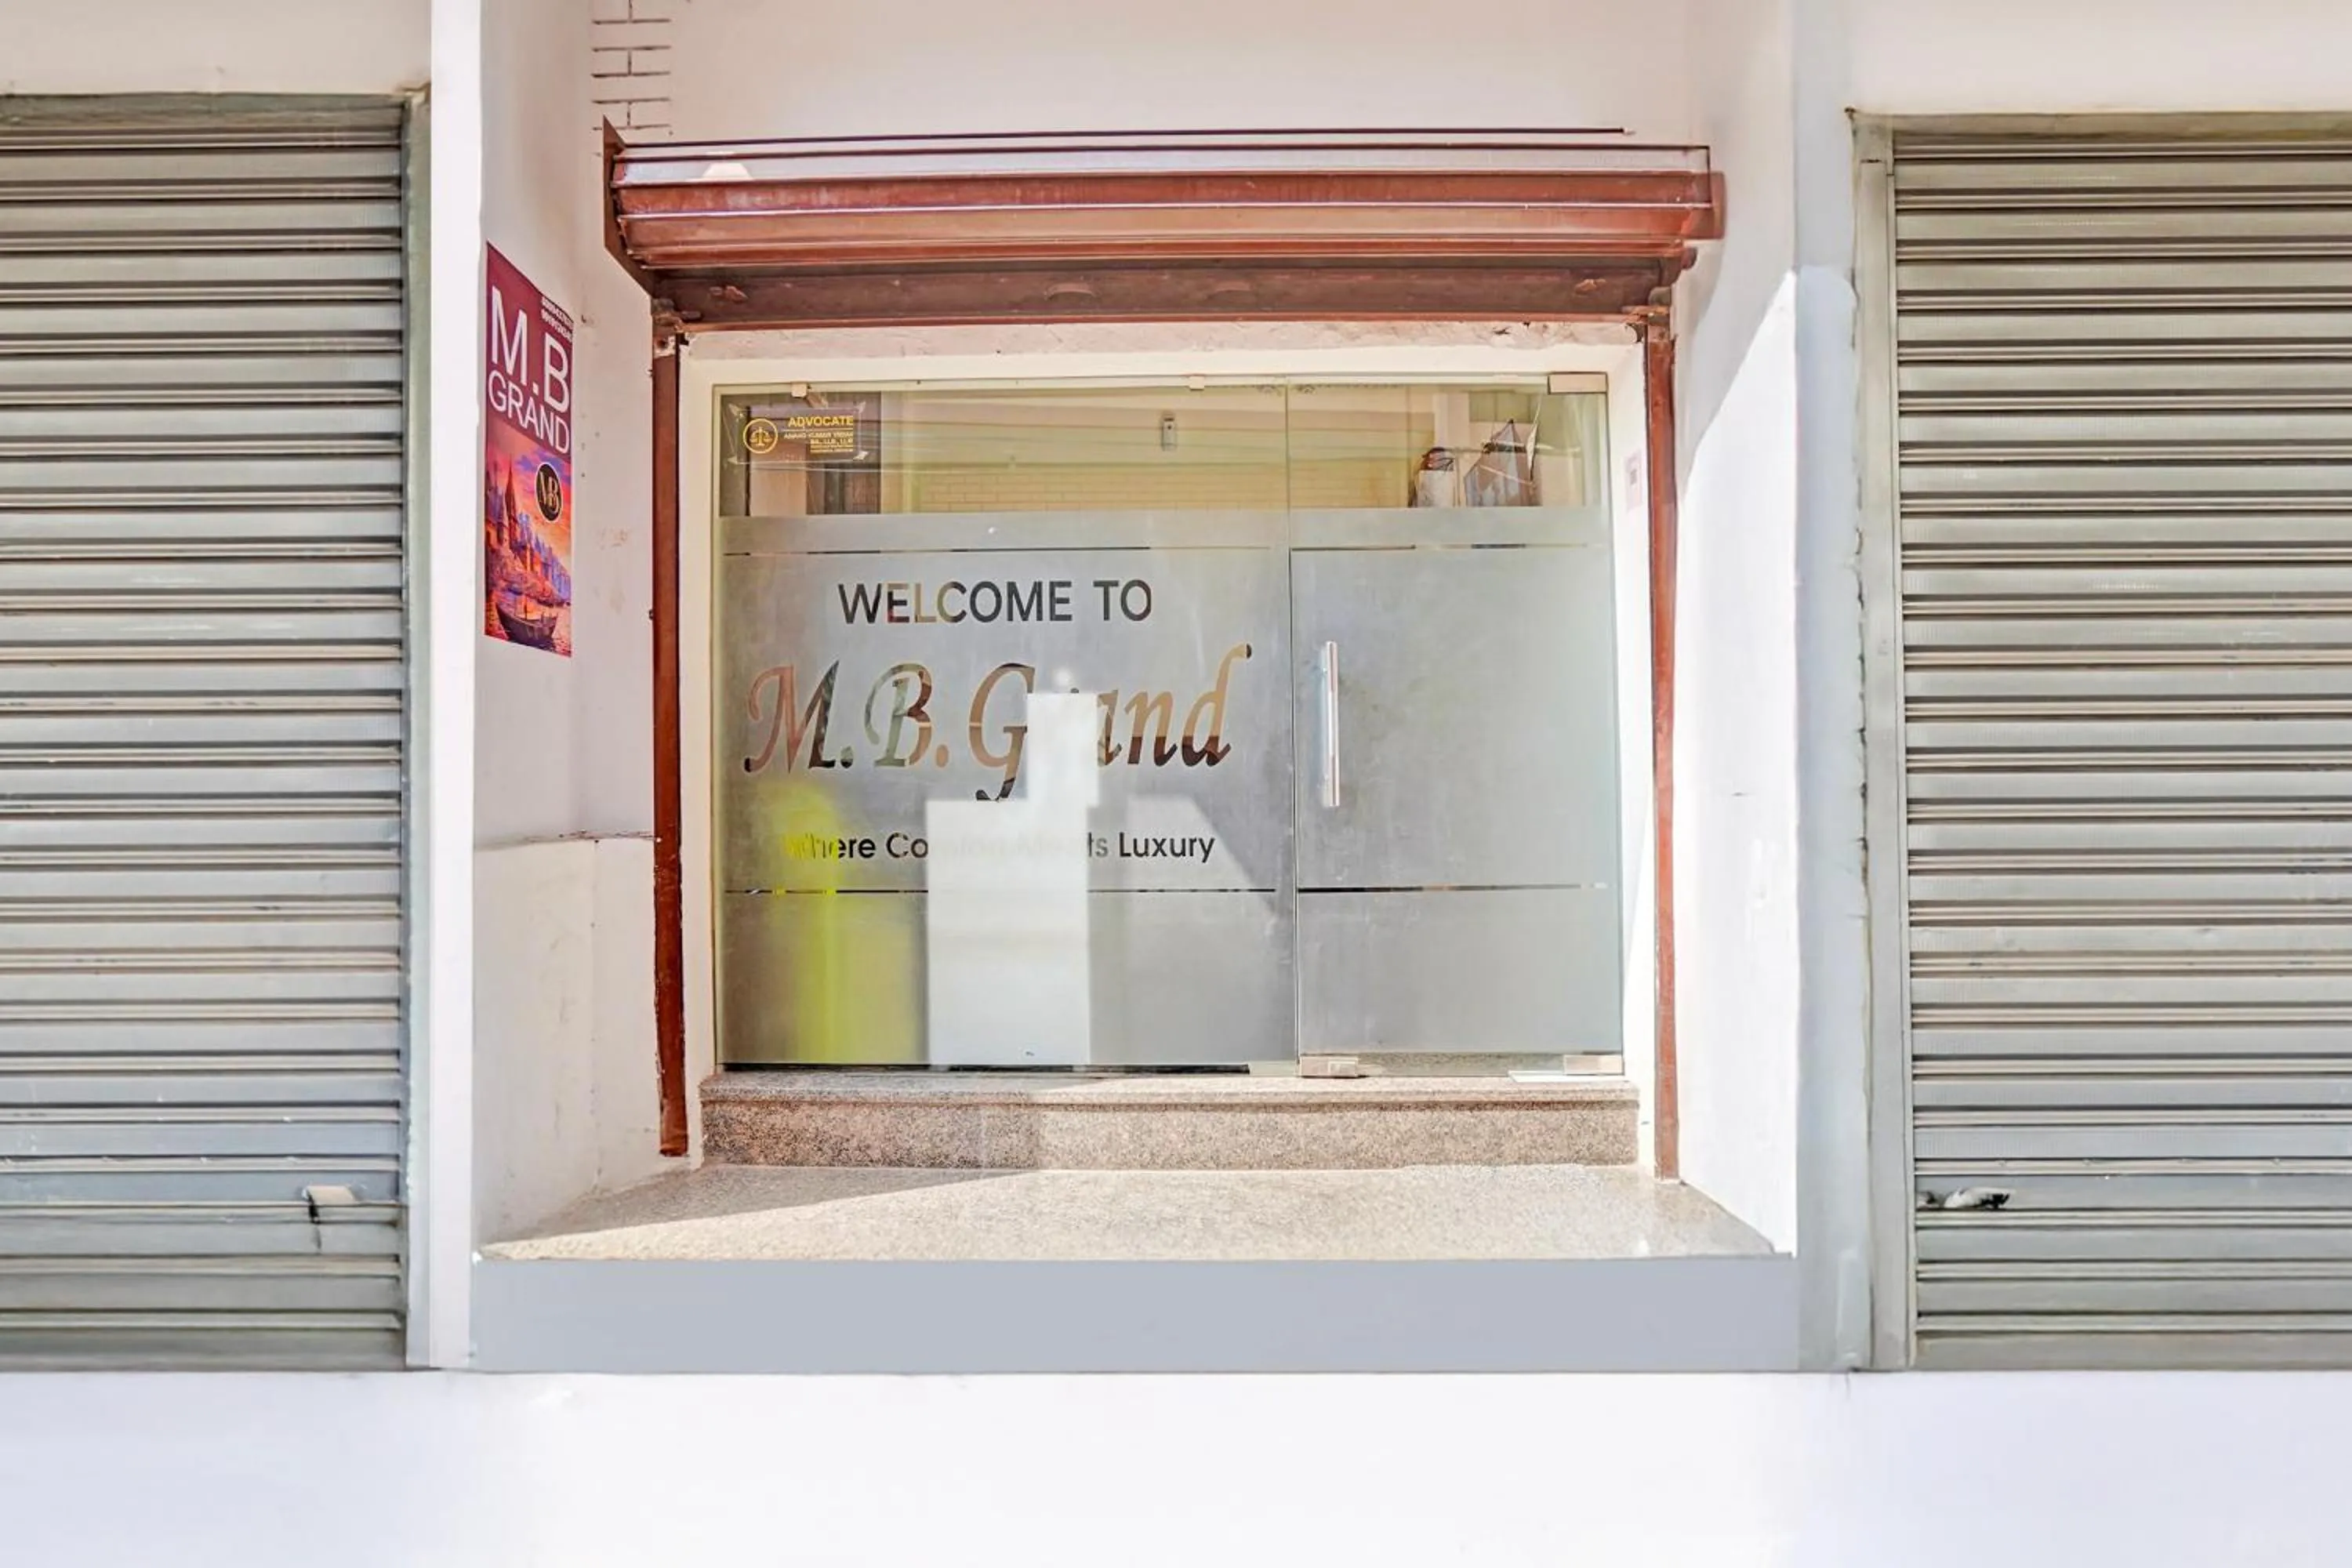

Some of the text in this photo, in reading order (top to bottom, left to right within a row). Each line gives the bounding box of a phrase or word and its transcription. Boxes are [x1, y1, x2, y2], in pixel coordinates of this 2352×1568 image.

[488, 369, 570, 455] GRAND
[788, 416, 854, 427] ADVOCATE
[837, 579, 1152, 625] WELCOME TO
[1118, 832, 1216, 863] Luxury
